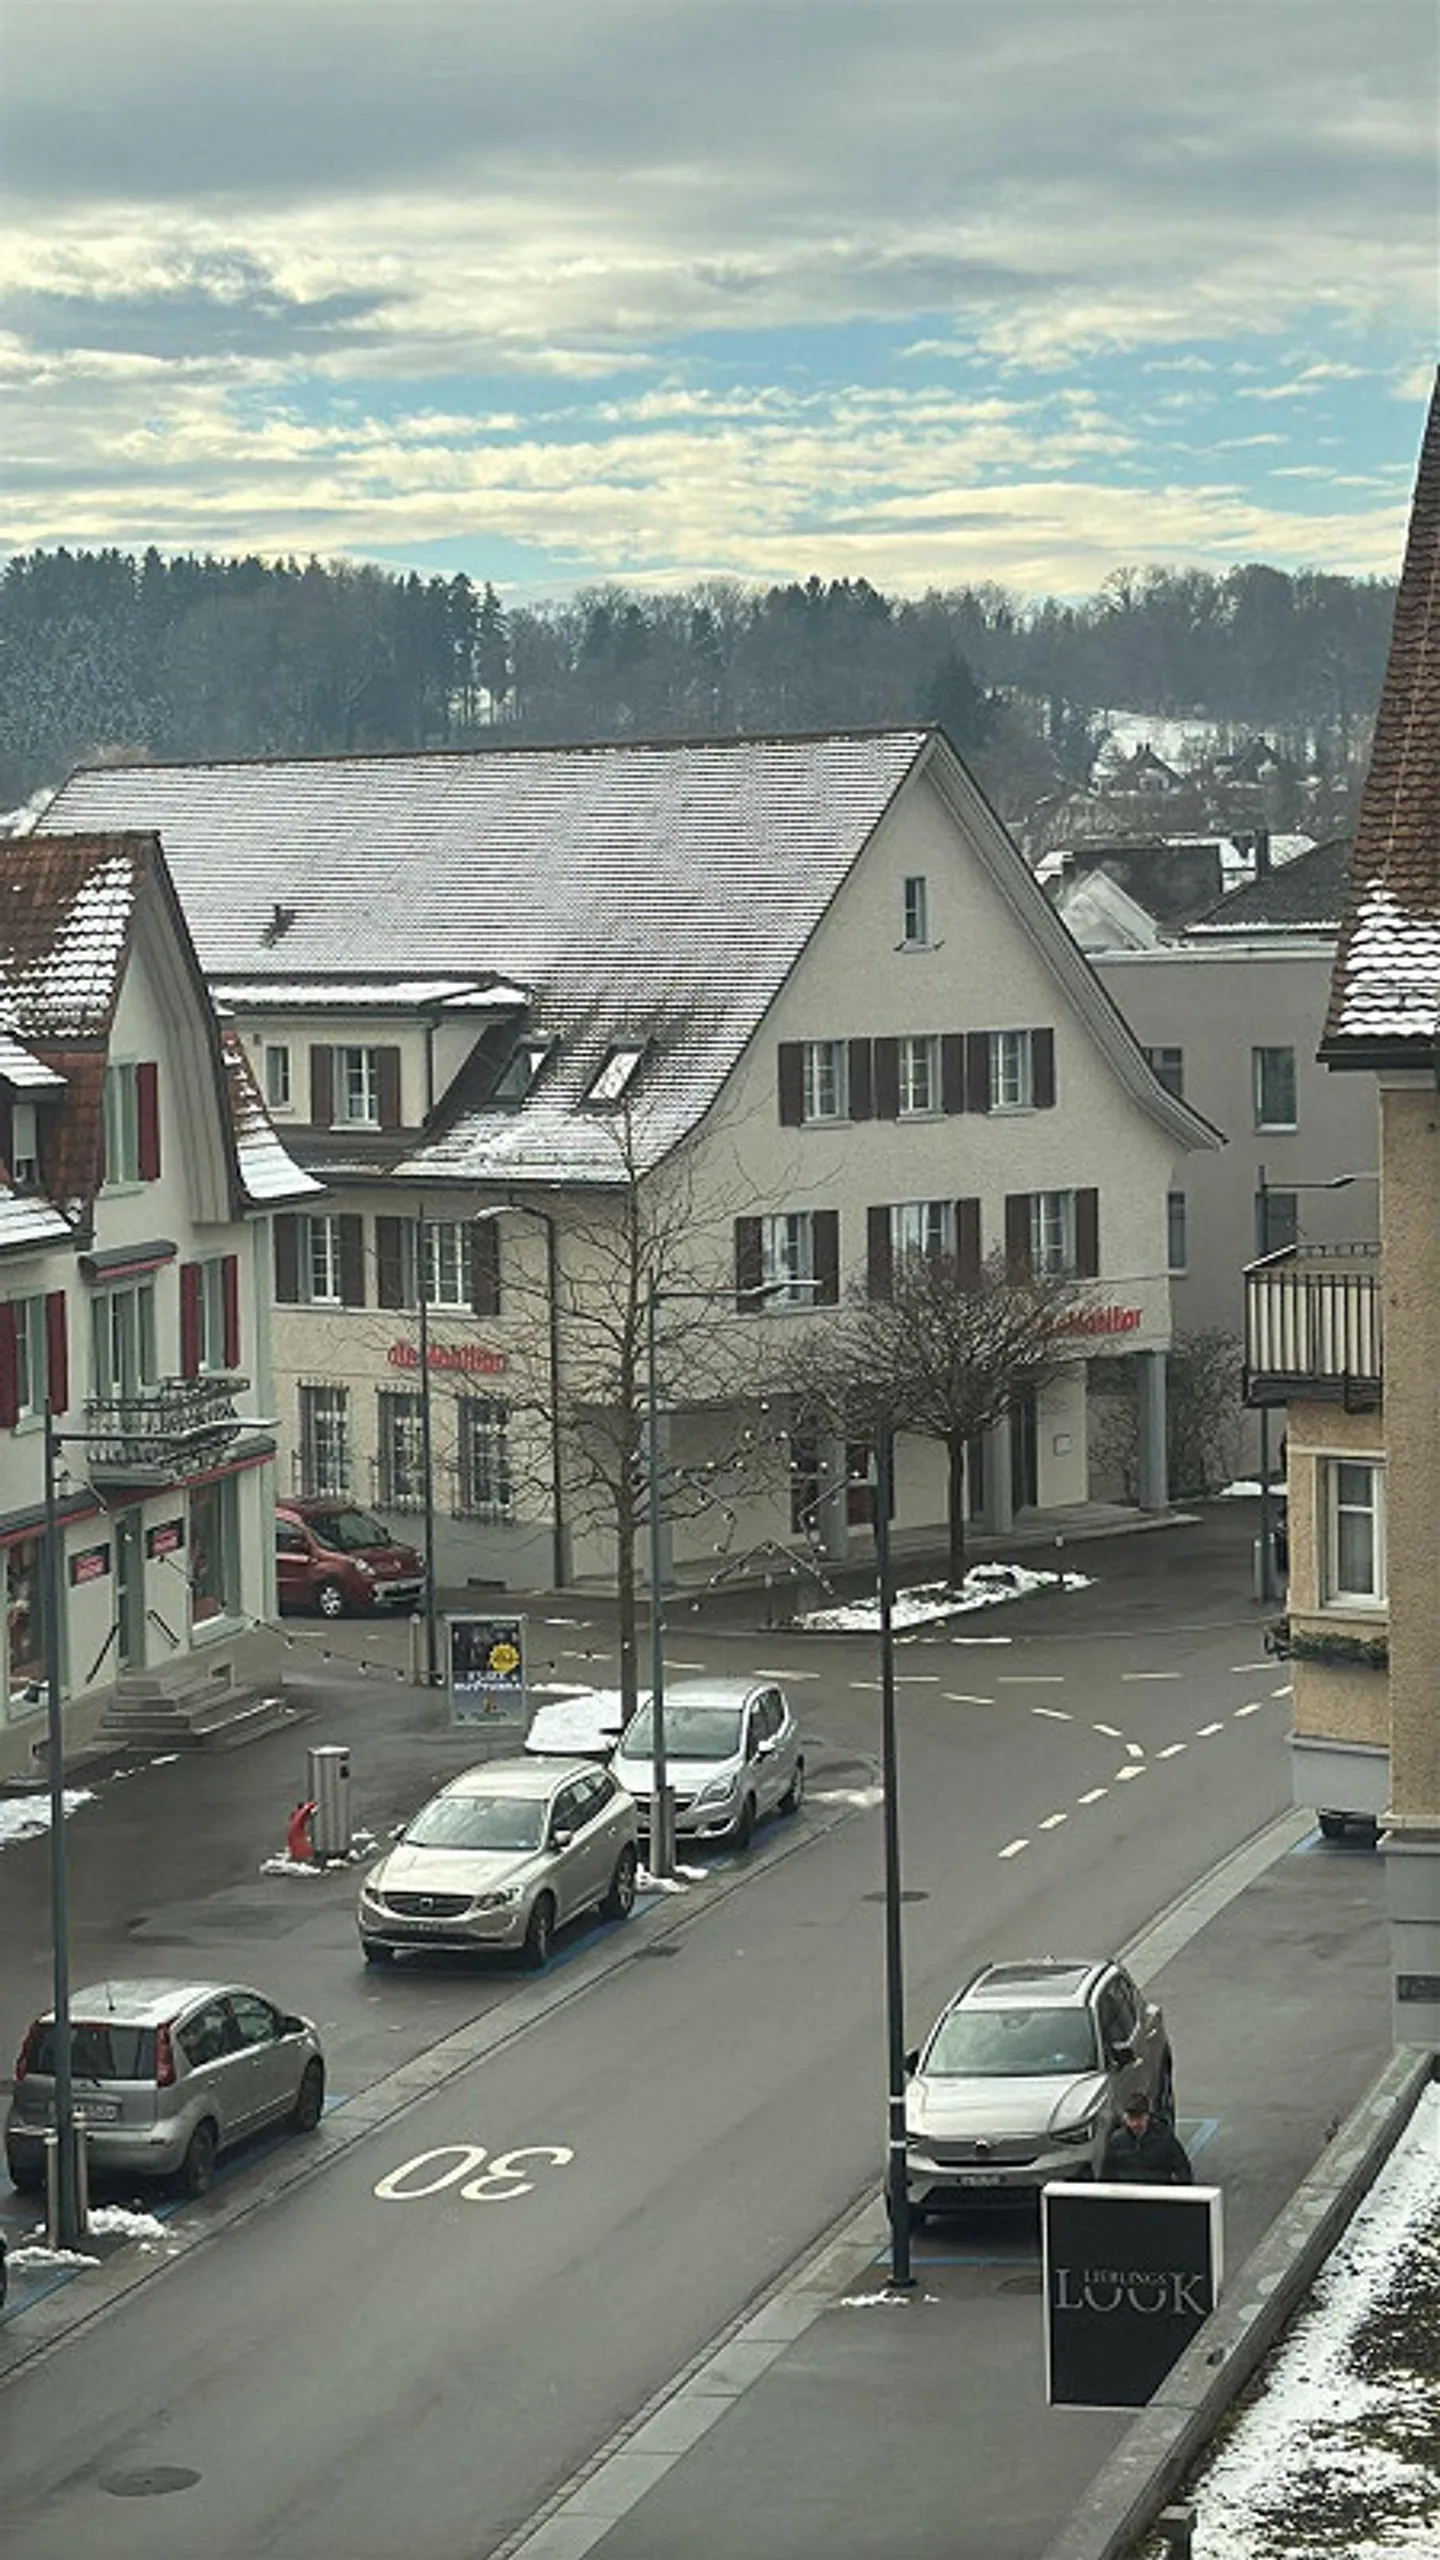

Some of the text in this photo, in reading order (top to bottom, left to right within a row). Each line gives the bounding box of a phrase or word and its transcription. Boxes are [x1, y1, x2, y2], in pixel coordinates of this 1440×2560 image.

[374, 2144, 574, 2200] 30
[1054, 2268, 1208, 2316] LOOK
[1084, 2269, 1167, 2286] LIEBLINGS
